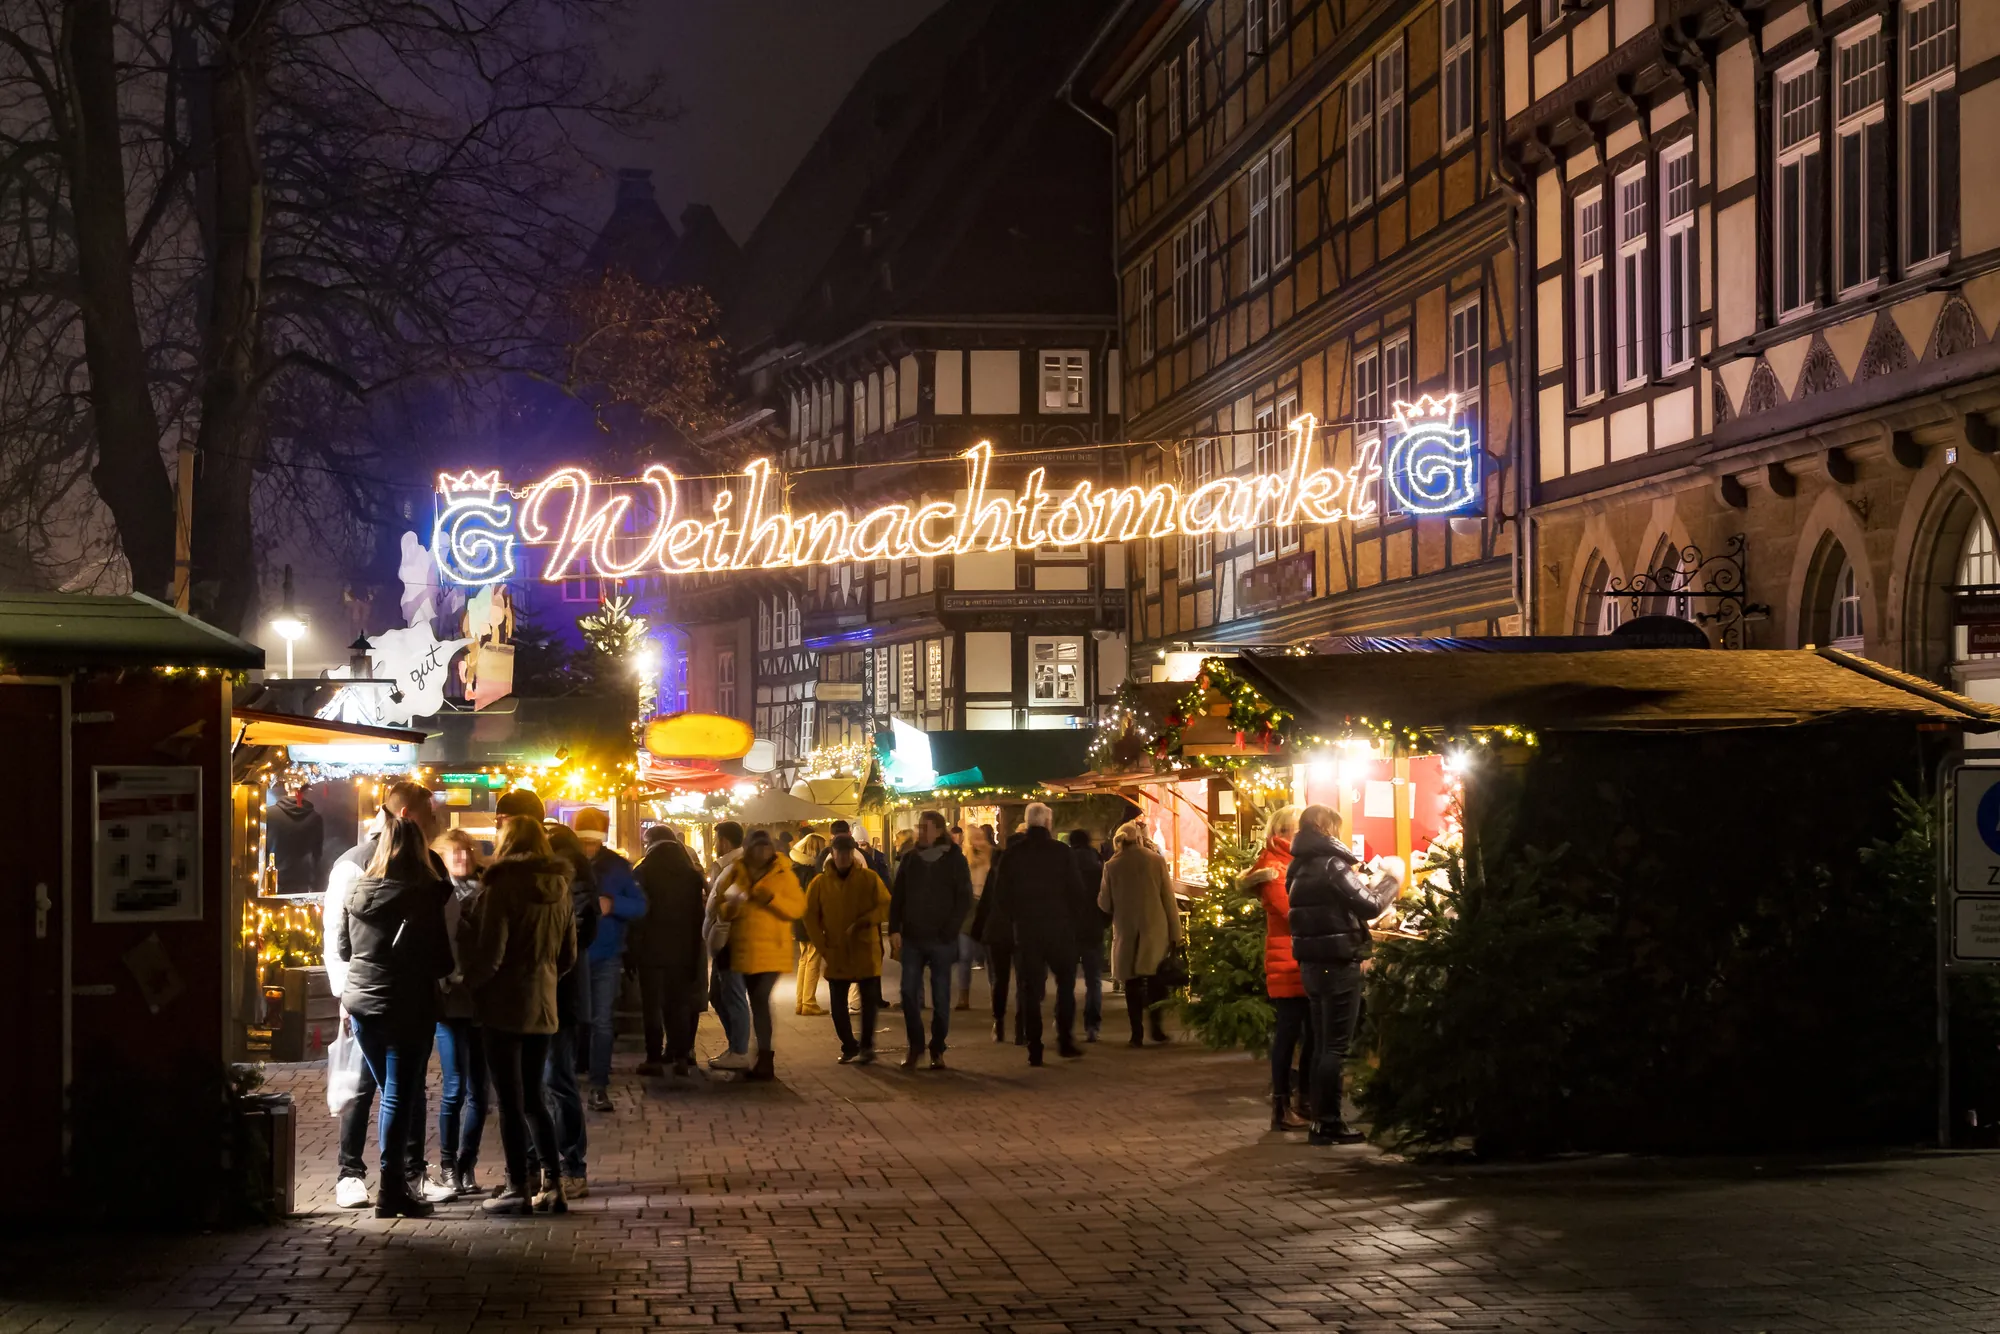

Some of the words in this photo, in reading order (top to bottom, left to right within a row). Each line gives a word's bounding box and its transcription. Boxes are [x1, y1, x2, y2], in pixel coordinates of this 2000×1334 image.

[432, 497, 515, 586] G
[518, 411, 1383, 582] Weihnachtsmarkt
[1388, 422, 1475, 514] G
[410, 643, 443, 691] gut
[1987, 865, 2000, 886] Z
